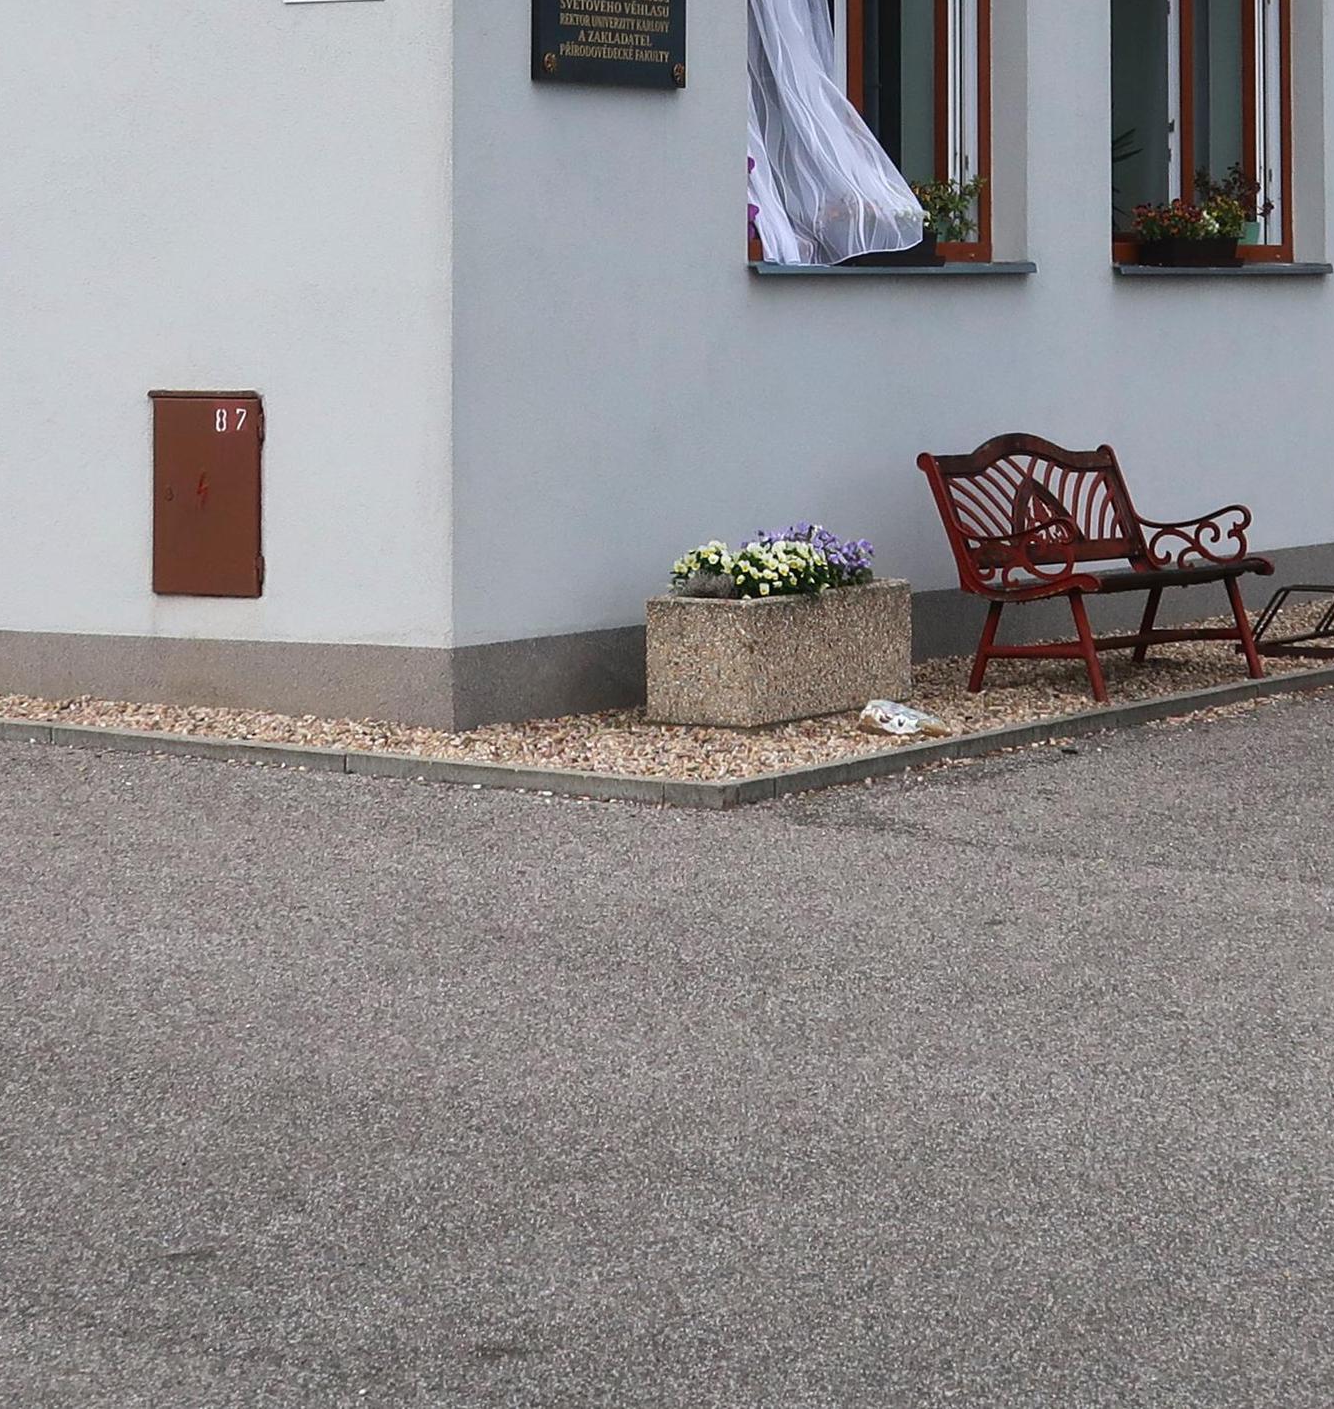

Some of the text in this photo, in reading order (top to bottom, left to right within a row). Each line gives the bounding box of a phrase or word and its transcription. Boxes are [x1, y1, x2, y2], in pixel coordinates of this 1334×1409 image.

[624, 1, 669, 17] VĚHLASU
[560, 12, 670, 33] REKTOR UNIVERZITY KARLOVY
[578, 30, 653, 47] A ZAKLADATEL
[559, 41, 670, 63] PŘÍRODOVĚDECKÉ FAKULTY
[216, 408, 247, 432] 87
